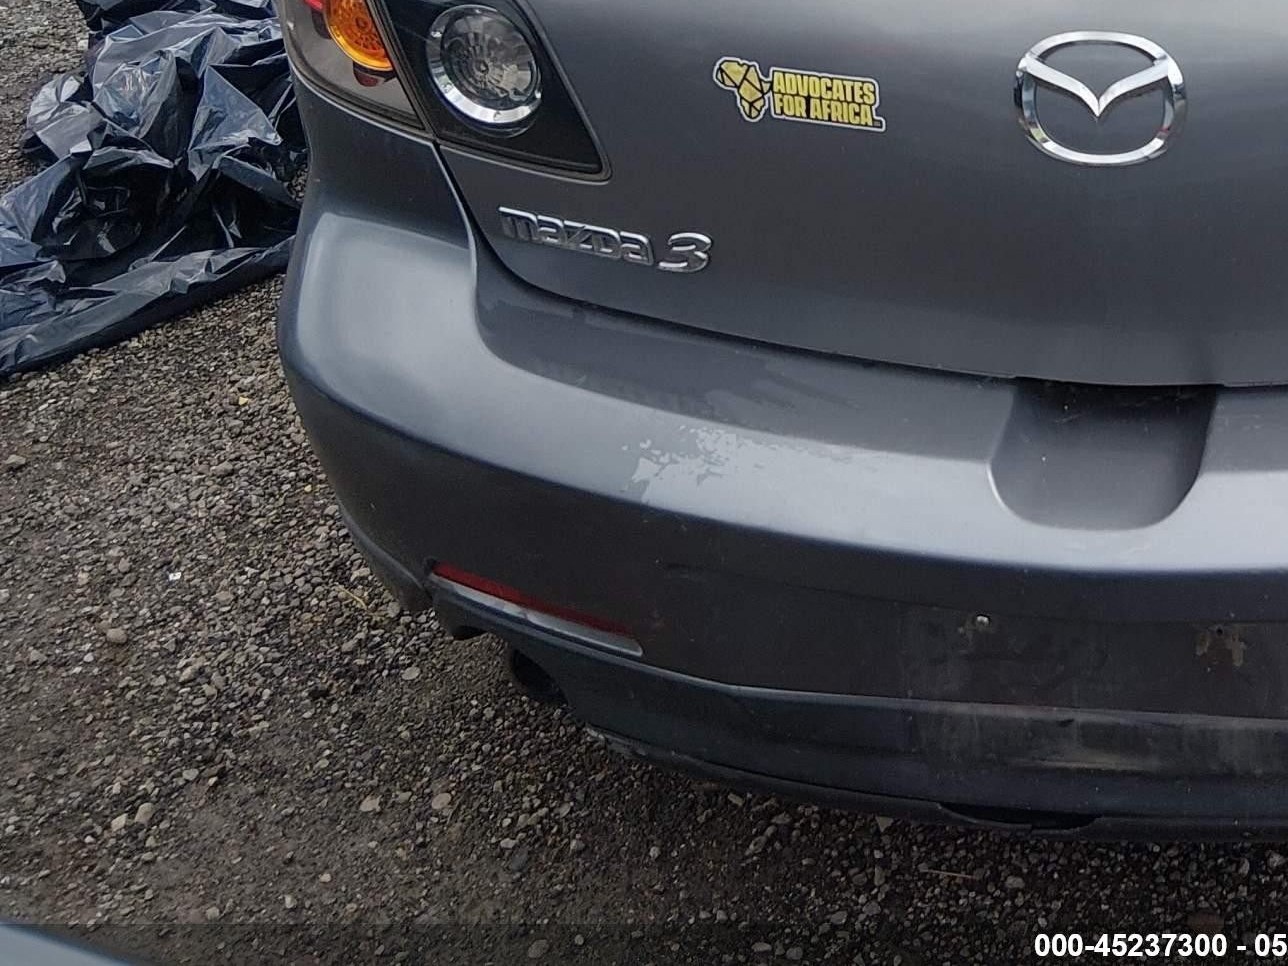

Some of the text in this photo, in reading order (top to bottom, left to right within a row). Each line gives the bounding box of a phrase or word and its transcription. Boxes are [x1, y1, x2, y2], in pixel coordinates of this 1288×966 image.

[772, 70, 876, 105] ADVOCATES
[774, 92, 873, 127] FOR AFRICA
[658, 232, 712, 273] 3
